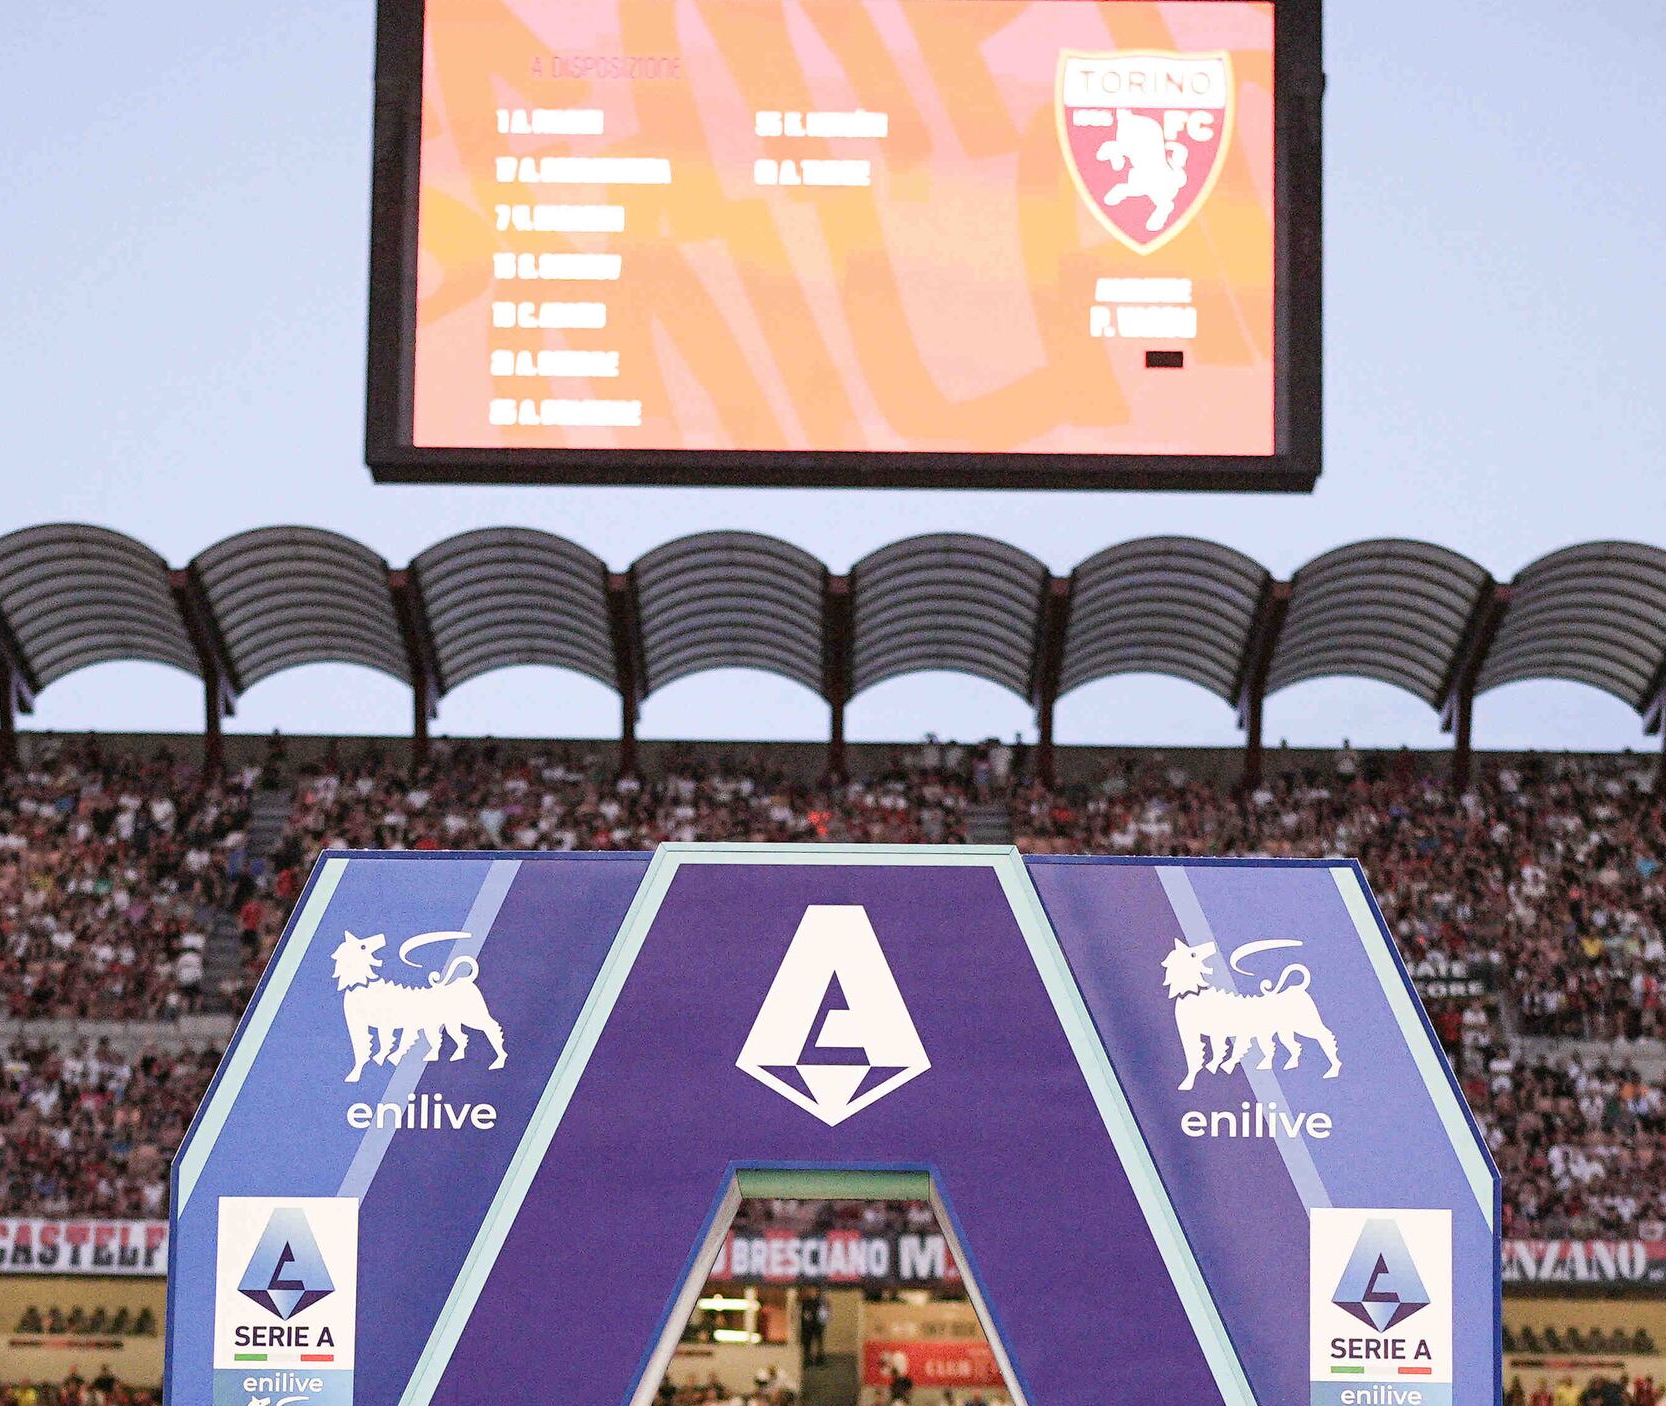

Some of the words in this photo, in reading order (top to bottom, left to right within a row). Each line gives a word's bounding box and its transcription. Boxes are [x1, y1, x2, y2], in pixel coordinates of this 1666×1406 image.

[1080, 70, 1211, 95] TORINO
[1164, 109, 1215, 142] FC
[346, 1092, 497, 1130] enilive
[1181, 1101, 1333, 1139] enilive
[732, 1236, 890, 1278] BRESCIANO
[234, 1325, 309, 1348] SERIE
[316, 1326, 335, 1348] A
[1330, 1337, 1406, 1360] SERIE
[1413, 1339, 1432, 1360] A
[242, 1372, 325, 1393] enilive
[1340, 1384, 1423, 1406] enilive
